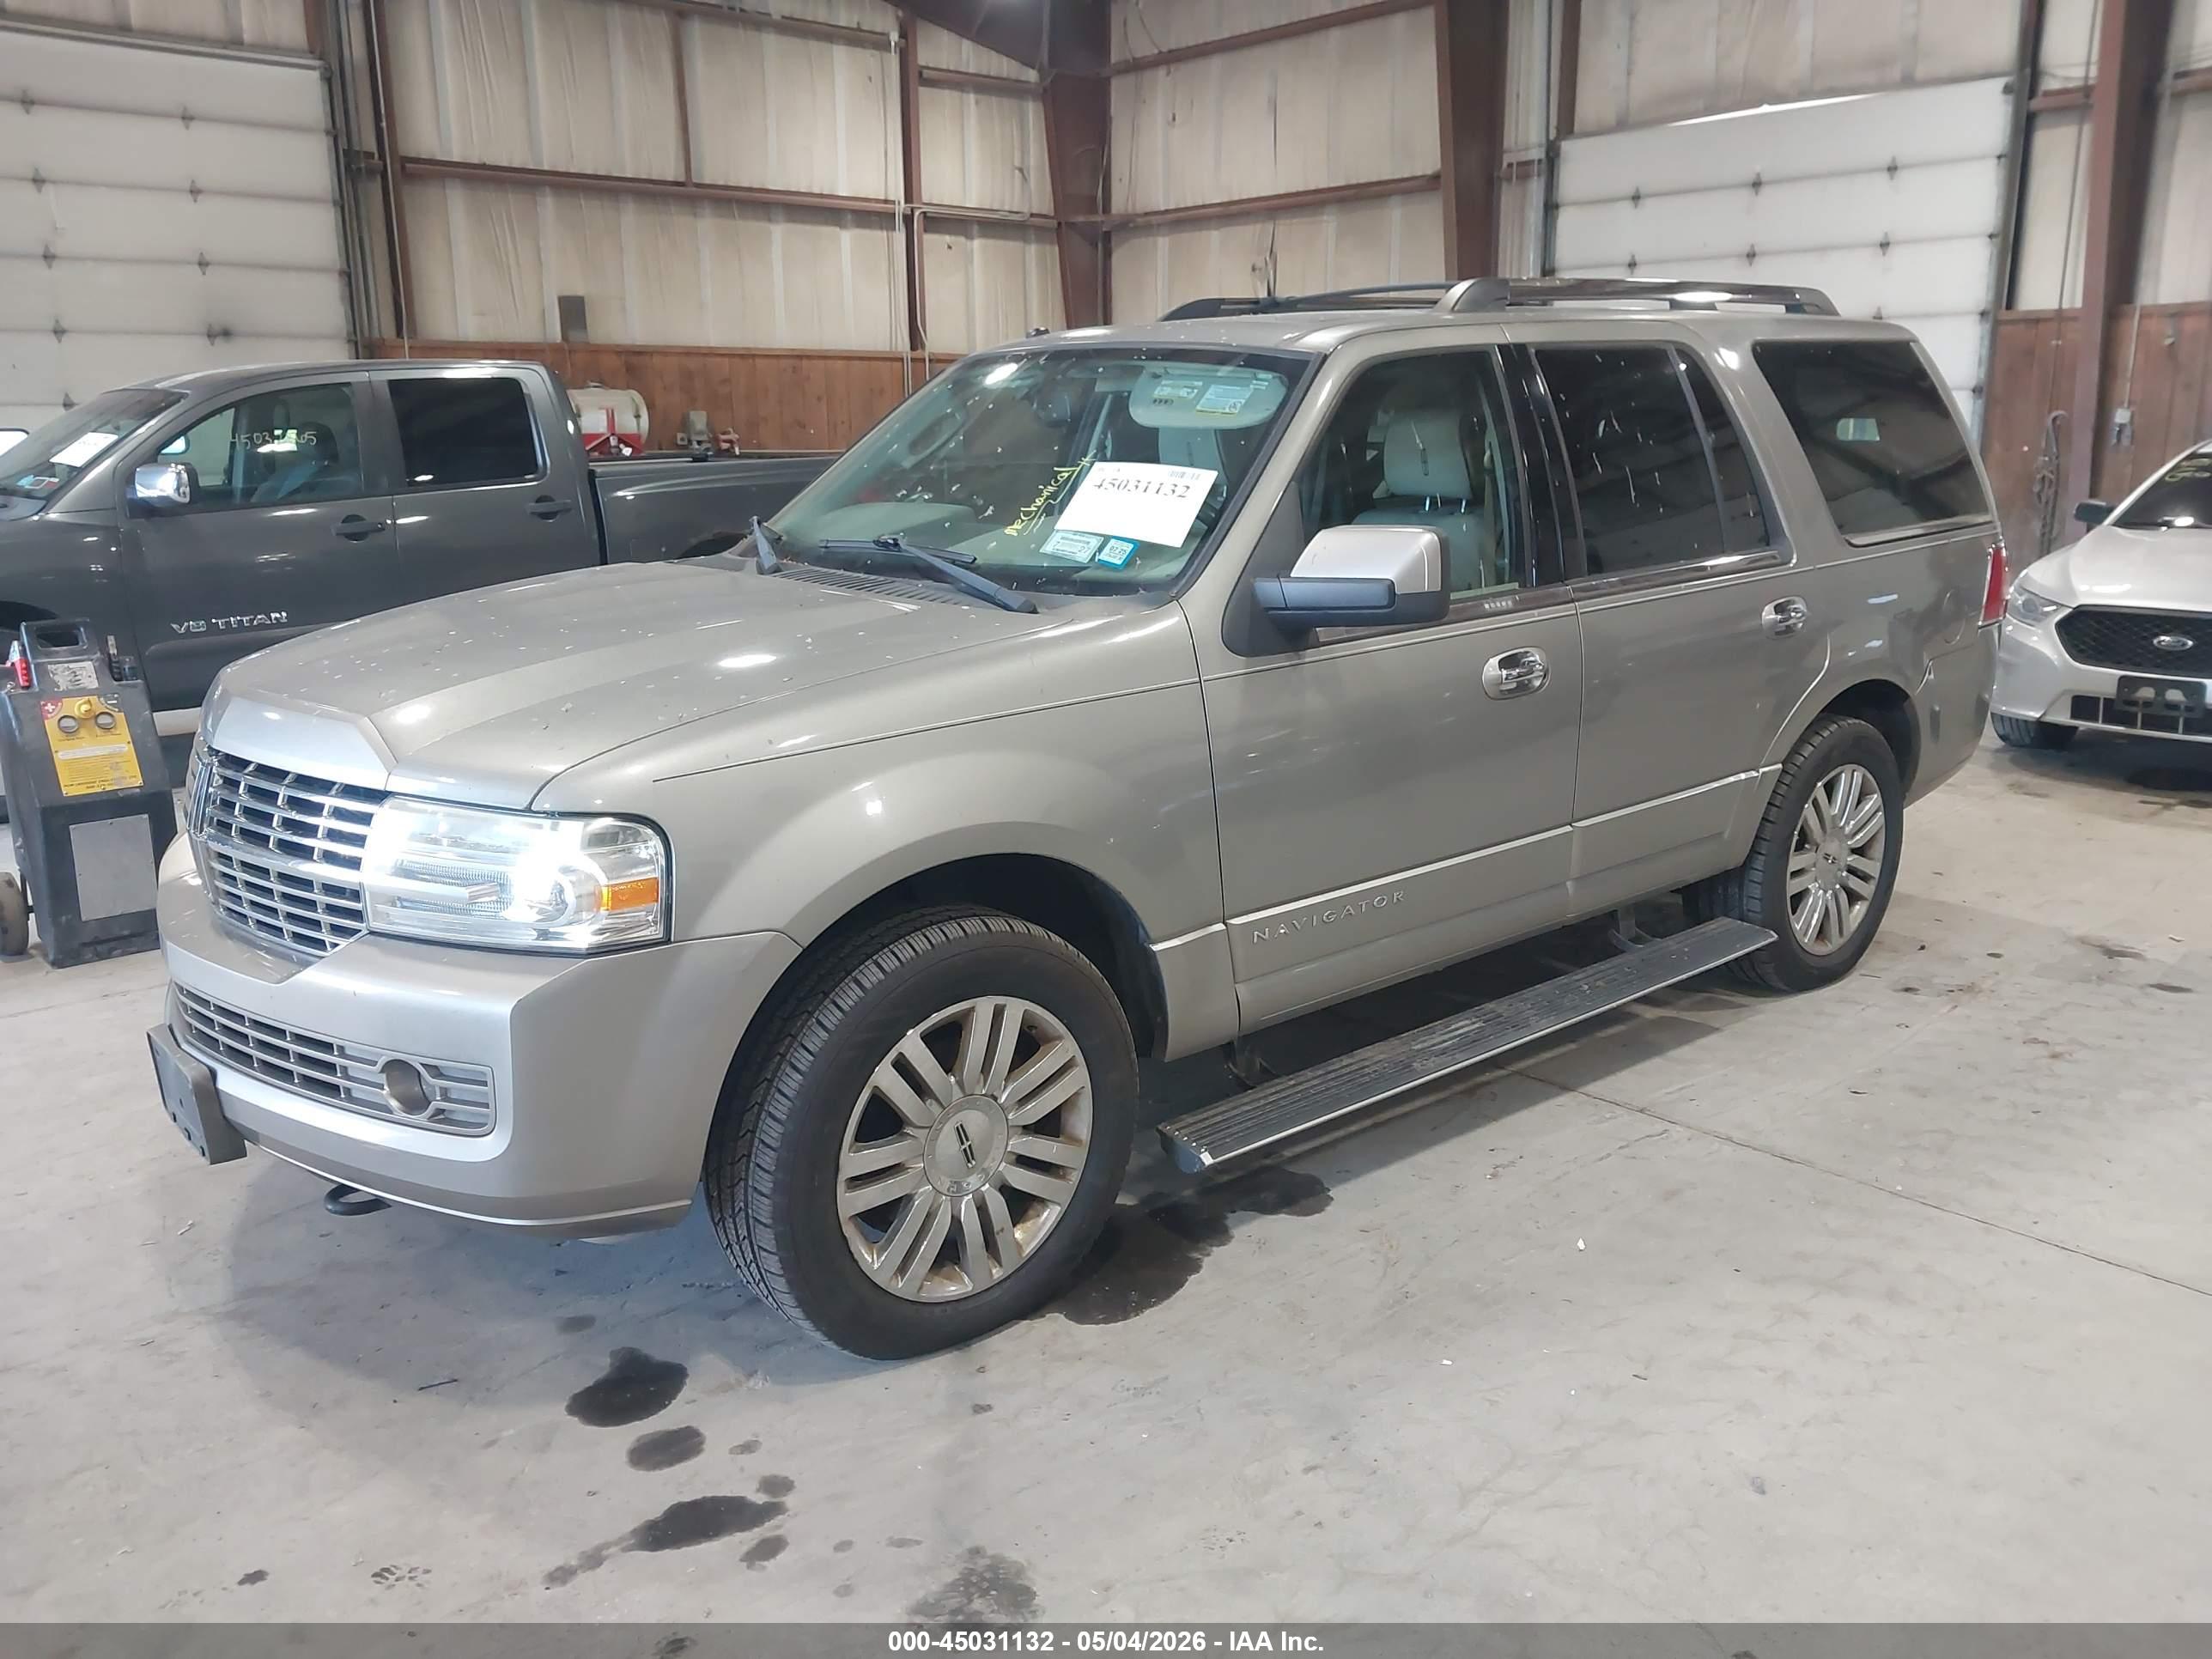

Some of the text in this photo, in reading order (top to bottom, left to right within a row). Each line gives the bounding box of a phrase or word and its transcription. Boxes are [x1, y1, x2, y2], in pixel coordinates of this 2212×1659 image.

[1093, 477, 1191, 498] 45031132
[170, 611, 289, 634] V8 TITAN
[1251, 890, 1406, 945] NAVIGATOR
